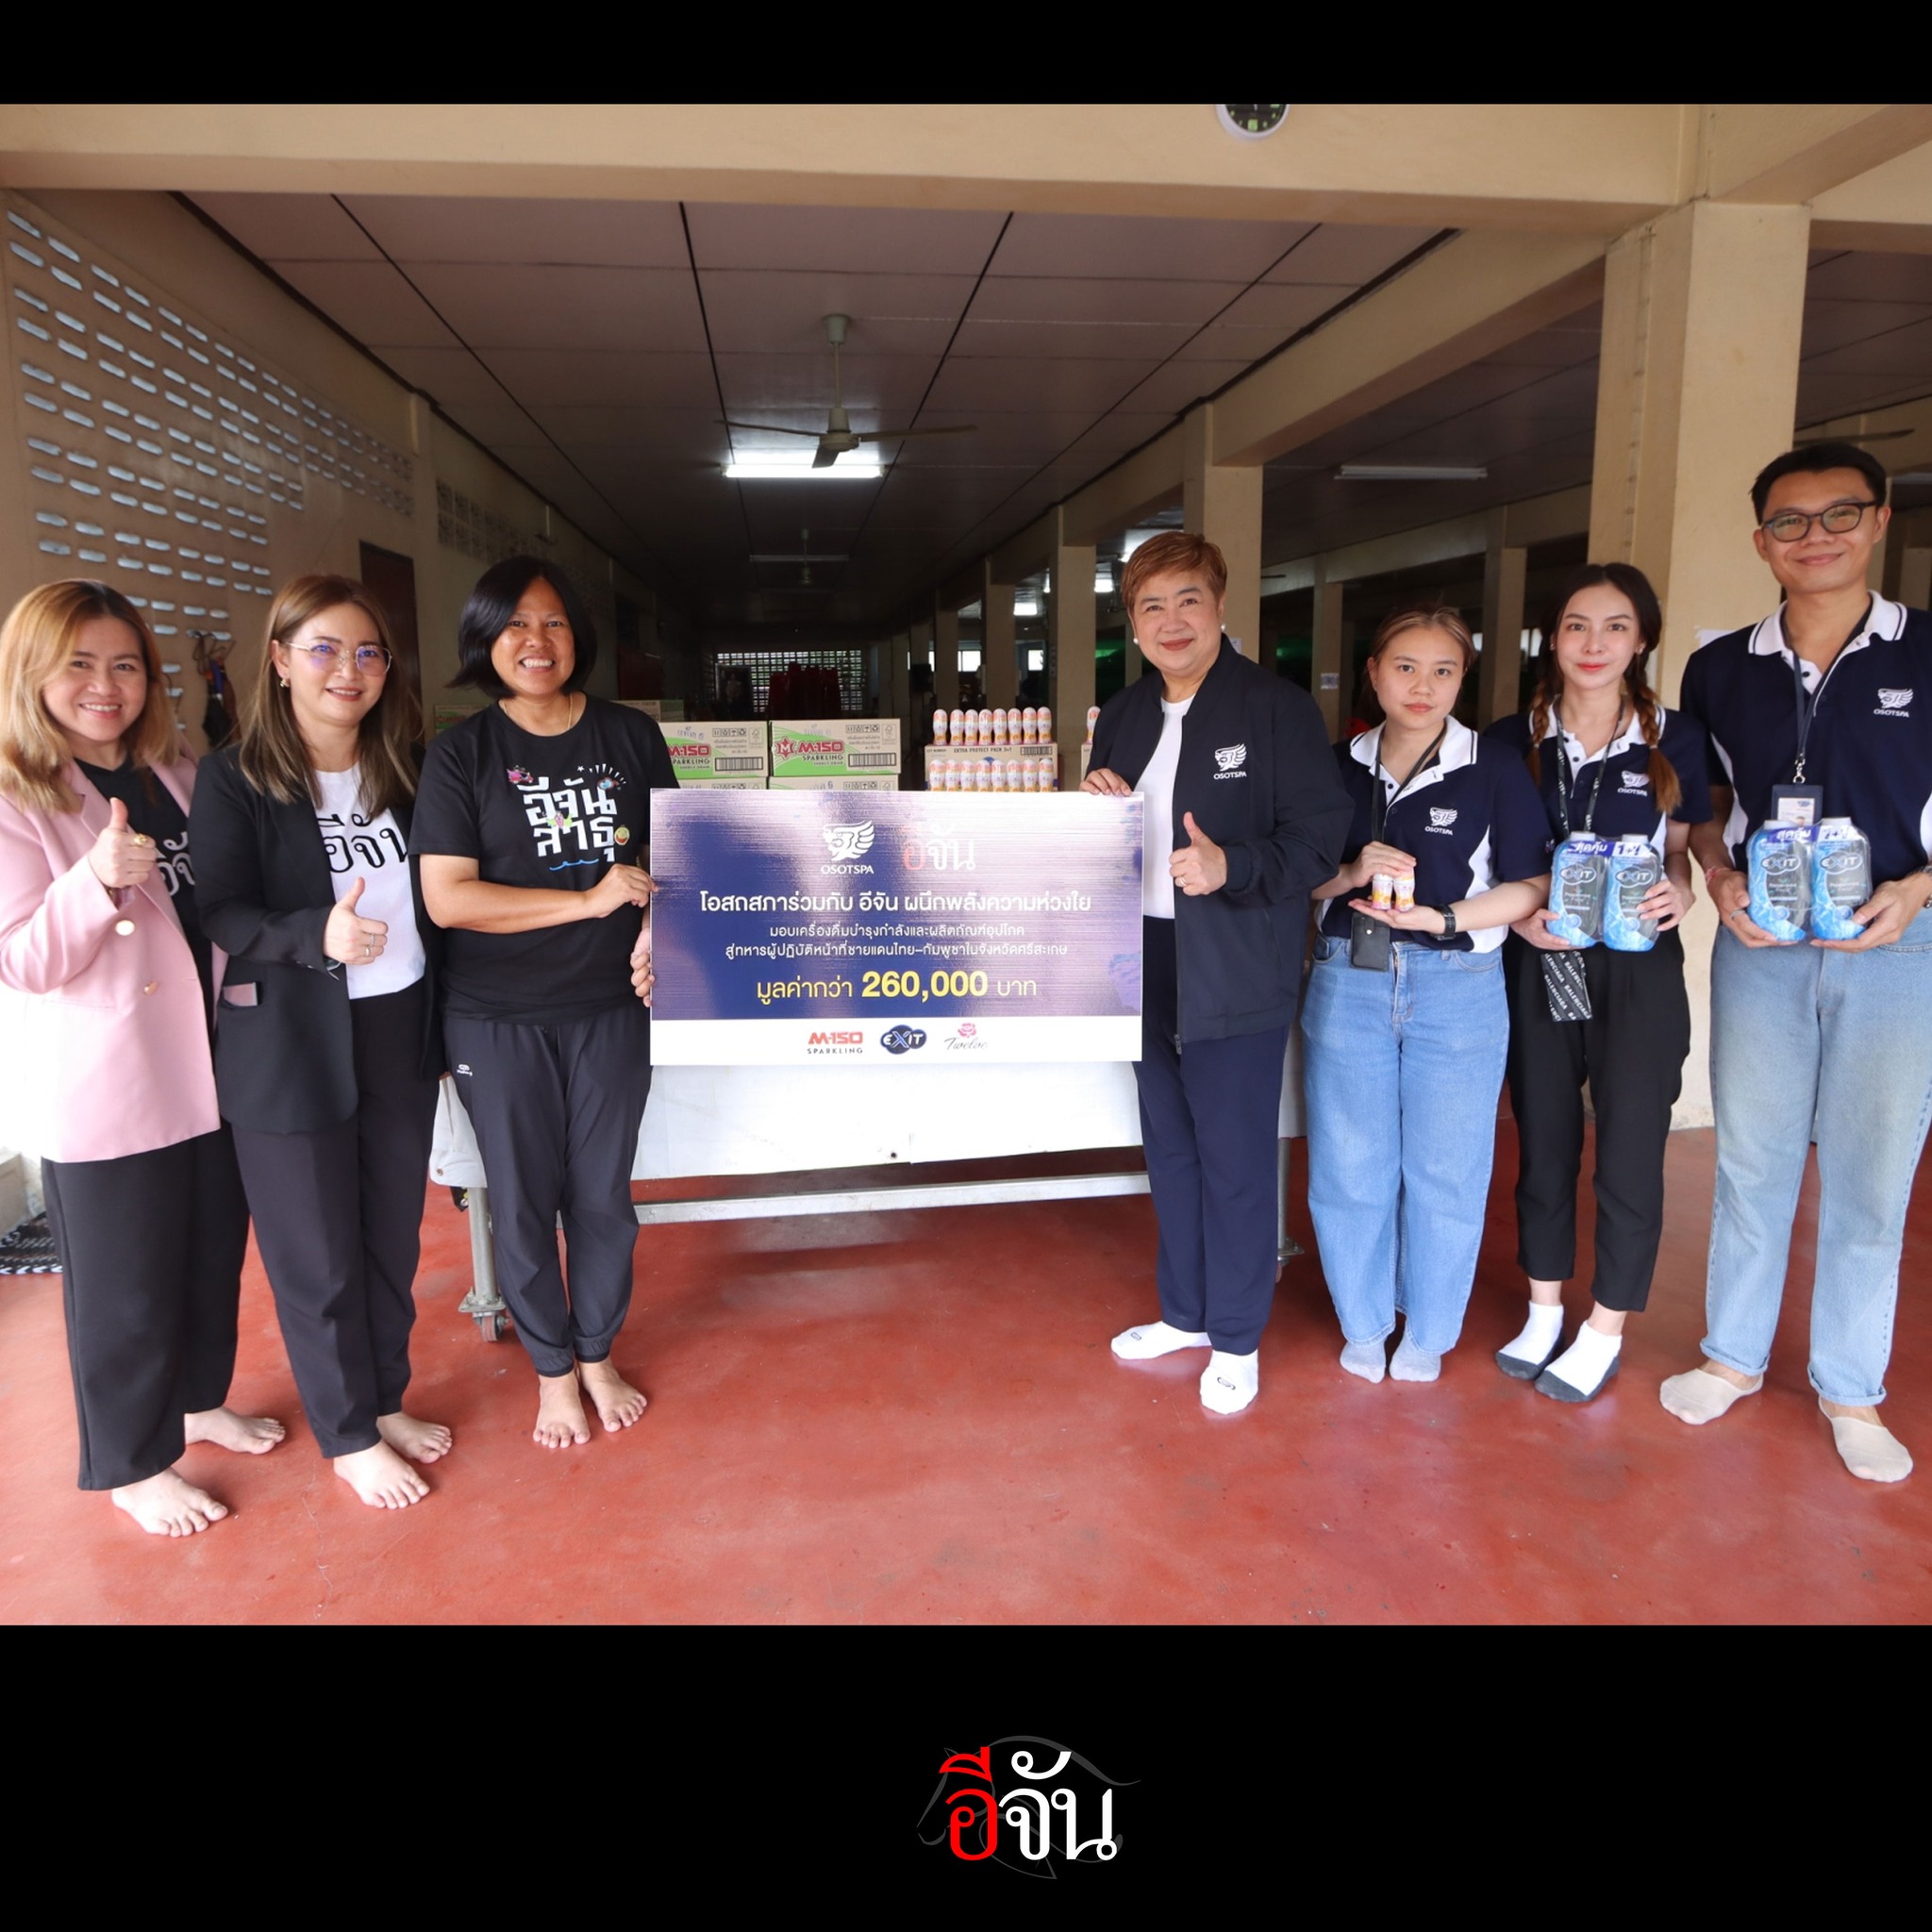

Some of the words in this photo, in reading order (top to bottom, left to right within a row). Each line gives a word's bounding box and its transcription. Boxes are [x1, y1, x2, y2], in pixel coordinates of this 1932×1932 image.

[1874, 708, 1909, 718] OSOTSPA
[1213, 771, 1247, 780] OSOTSPA
[517, 776, 618, 826] อีจัน
[1424, 825, 1454, 836] OSOTSPA
[1762, 858, 1796, 869] EXIT
[1822, 857, 1858, 868] EXIT
[821, 865, 874, 874] OSOTSPA
[700, 891, 854, 911] โอสถสภาร่วมกับ
[859, 891, 899, 911] อีจัน
[905, 891, 1091, 911] ผนึกพลังความห่วงใย
[770, 921, 1024, 940] มอบเครื่องดื่มบำรุงกำลังและผลิตภัณฑ์อุปโภค
[757, 974, 853, 1005] มูลค่ากว่า
[861, 971, 989, 1003] 260,000
[997, 979, 1037, 996] บาท
[808, 1031, 863, 1045] M-150
[882, 1030, 924, 1049] EXIT
